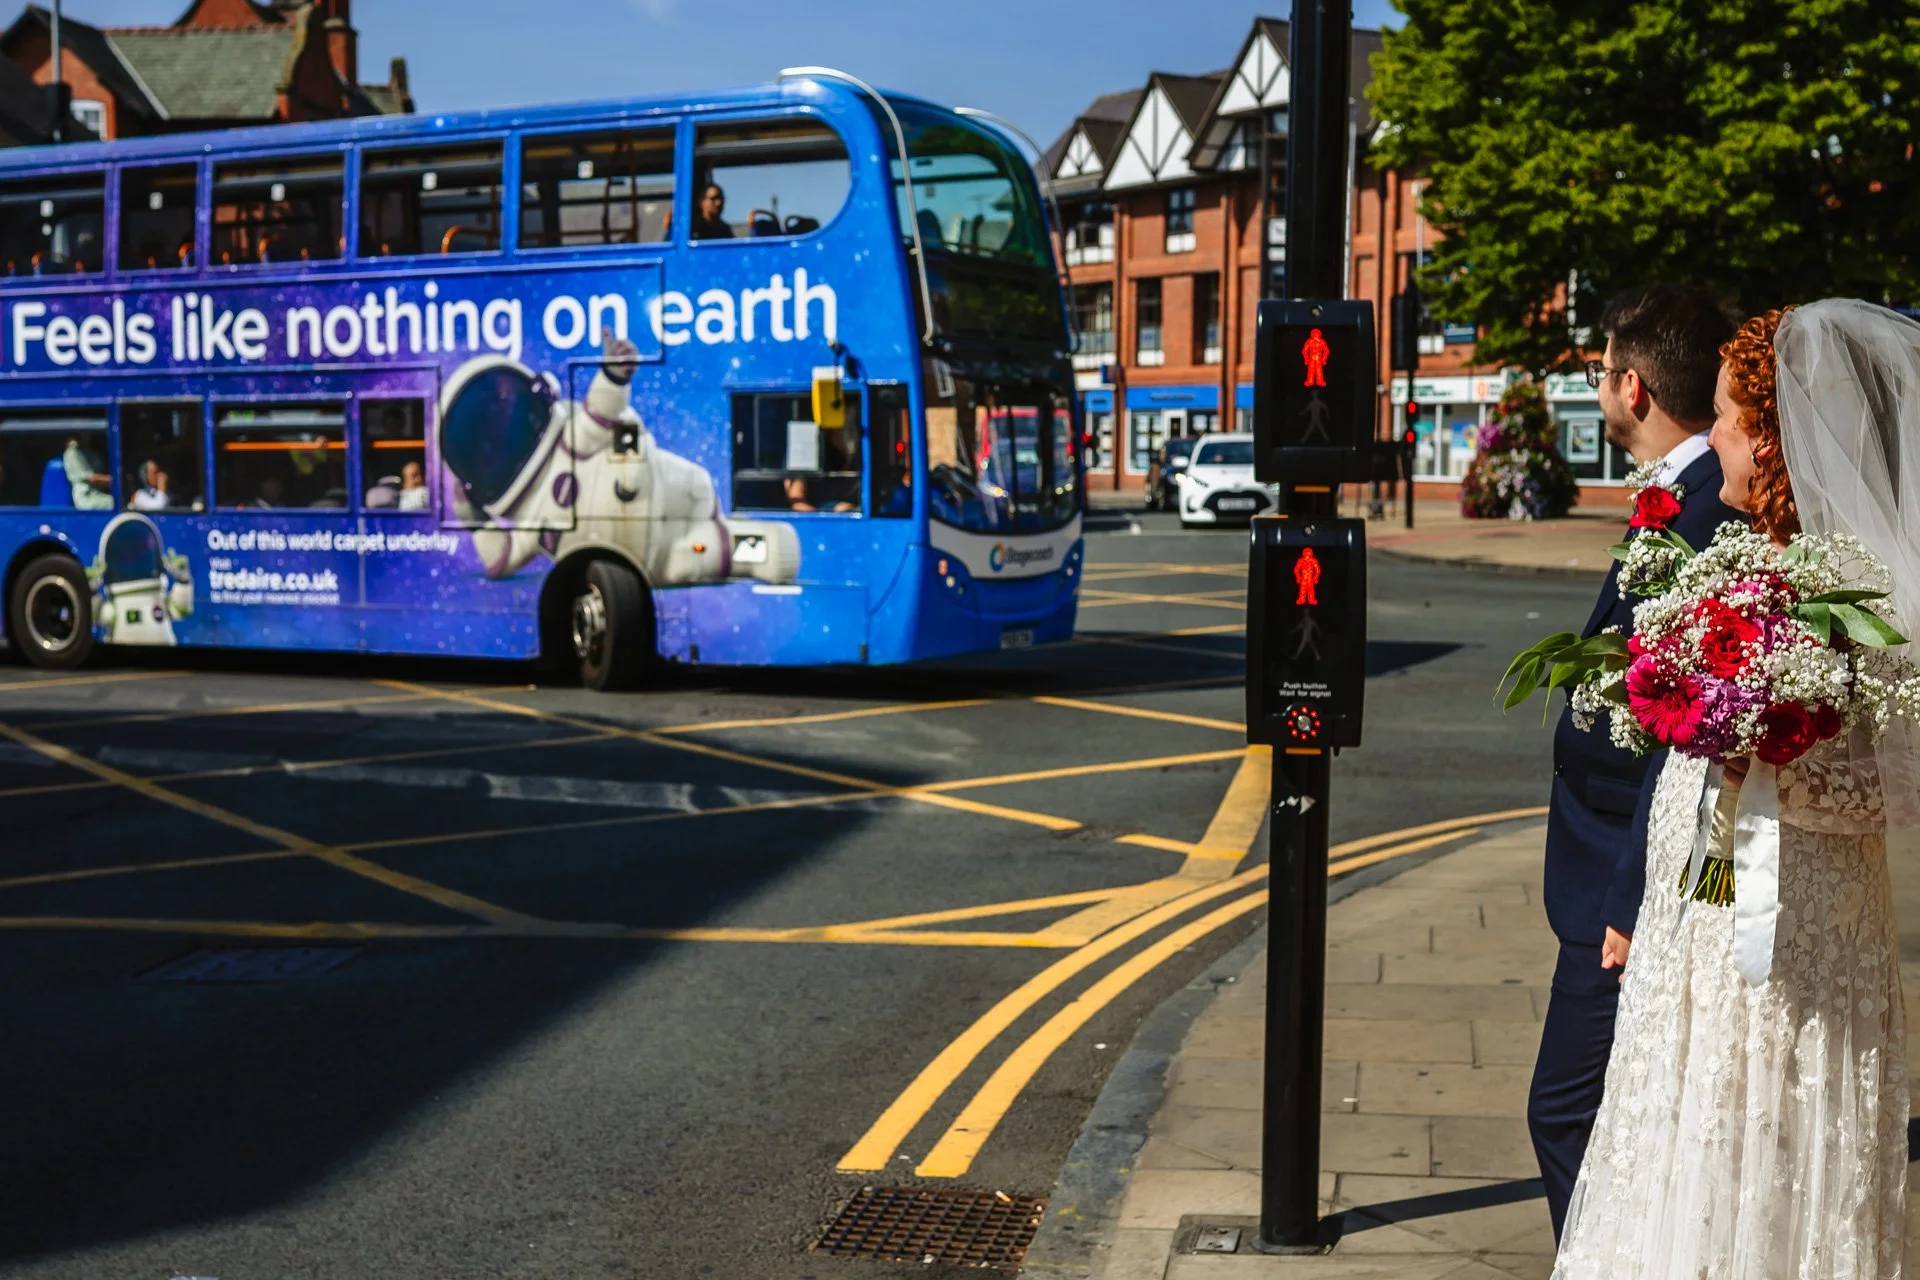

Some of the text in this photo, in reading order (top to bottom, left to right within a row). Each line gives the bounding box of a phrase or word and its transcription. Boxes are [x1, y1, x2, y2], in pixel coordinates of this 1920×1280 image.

[12, 267, 838, 367] Feels like nothing on earth
[207, 529, 459, 555] Out of this world carpet underlay
[208, 567, 338, 591] tredaire.co.uk
[1279, 689, 1296, 697] Wait
[1310, 690, 1331, 698] signal
[1283, 681, 1327, 690] Push button
